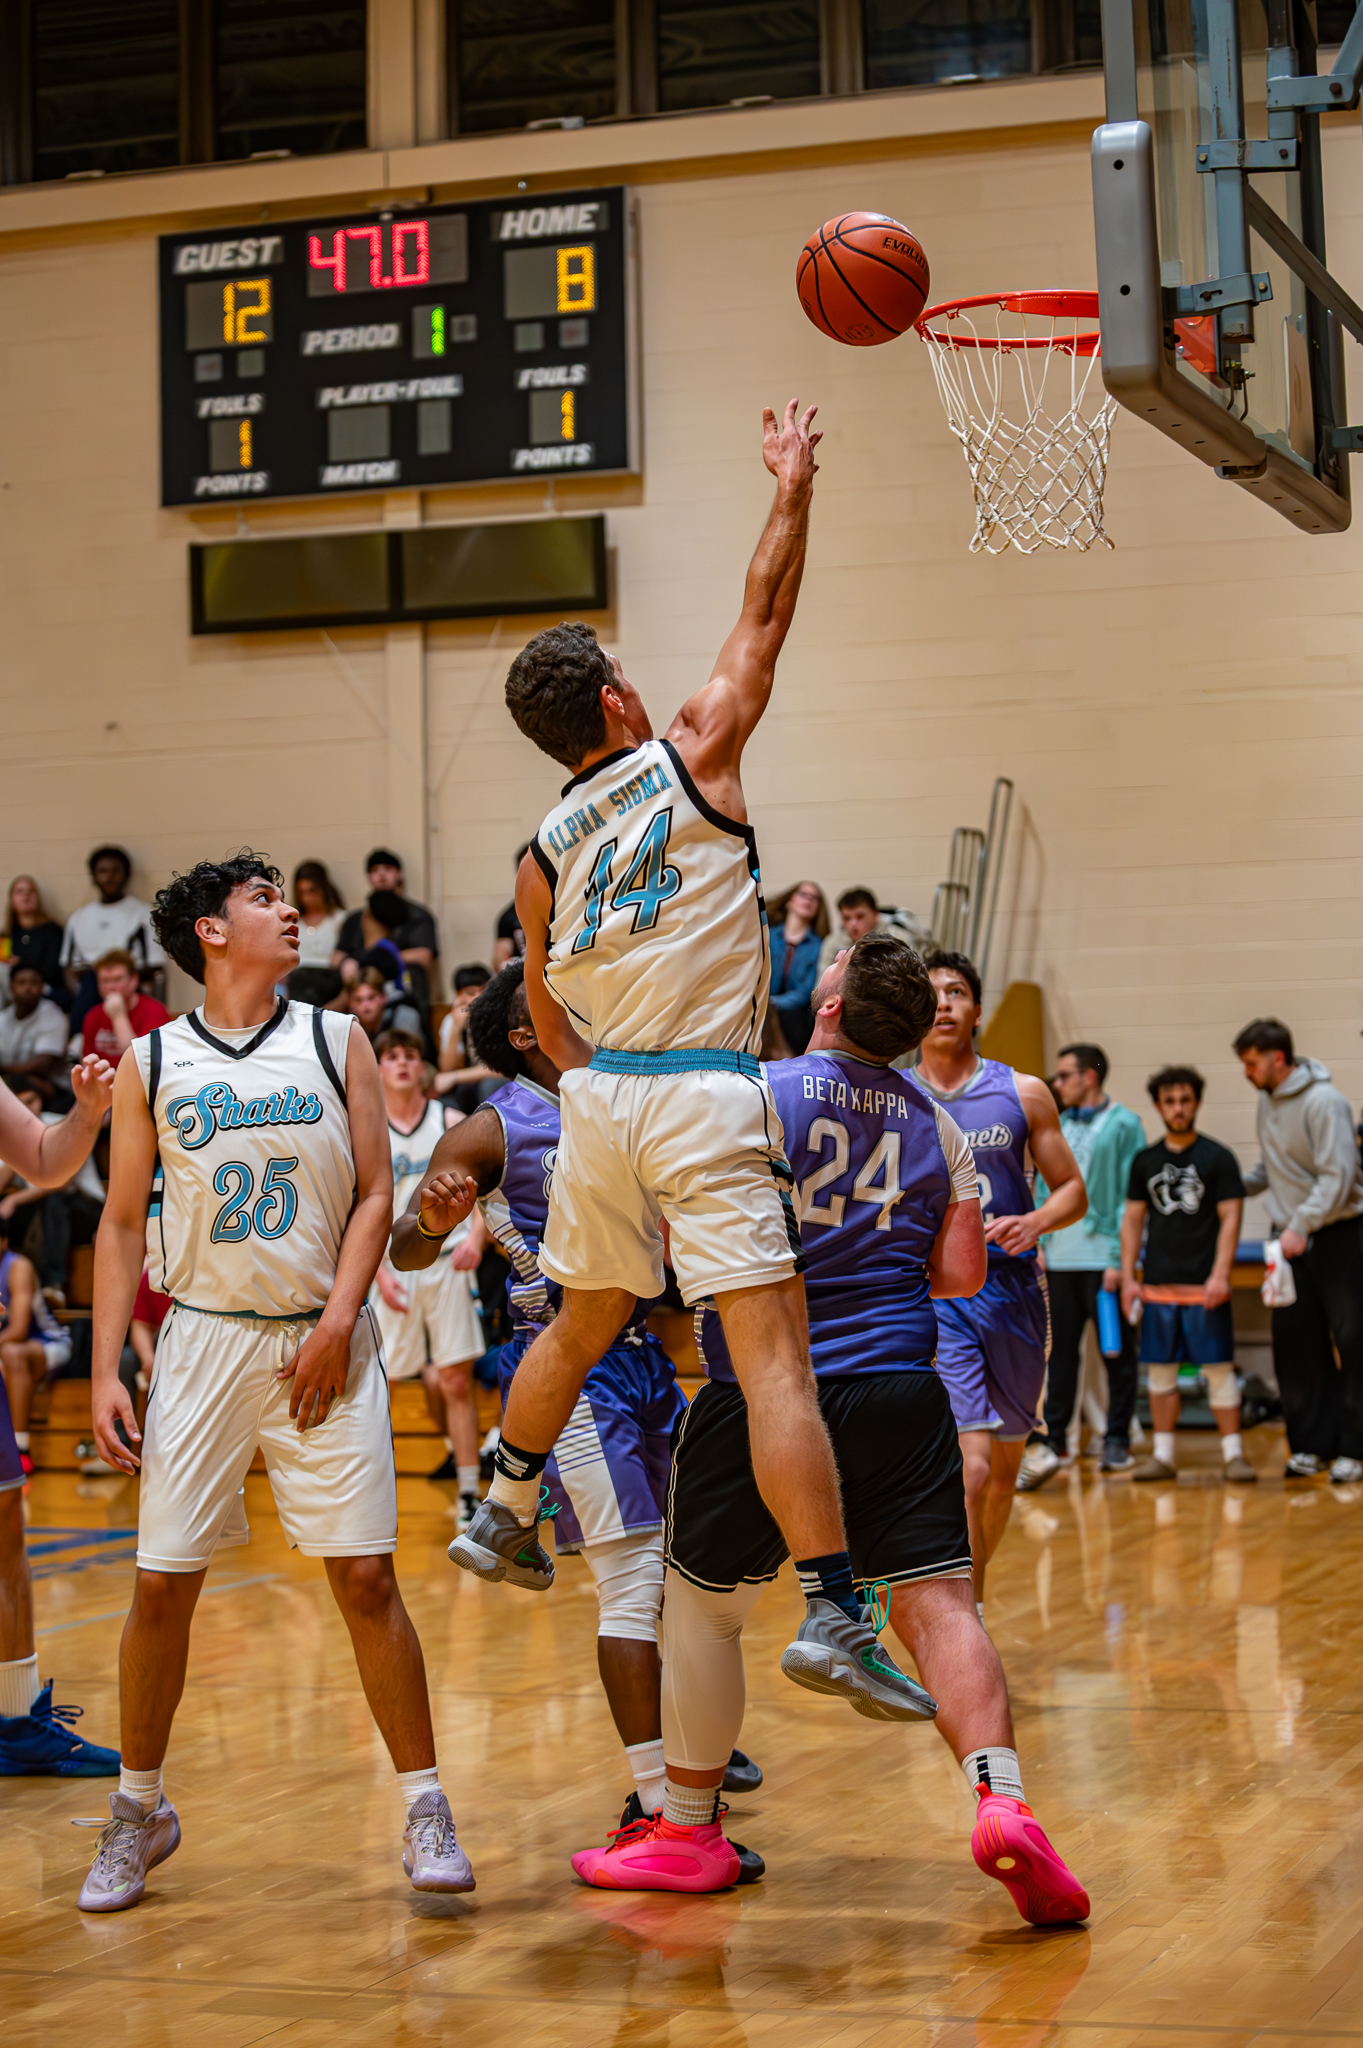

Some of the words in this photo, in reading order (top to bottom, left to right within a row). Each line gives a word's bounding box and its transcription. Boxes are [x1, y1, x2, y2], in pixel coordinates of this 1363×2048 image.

[501, 204, 598, 238] HOME
[176, 237, 281, 273] GUEST
[309, 220, 429, 292] 47.0
[556, 245, 594, 313] 8
[223, 278, 271, 344] 12
[431, 306, 445, 356] 1
[304, 324, 399, 355] PERIOD
[319, 376, 460, 407] PLAYER-FOUL
[518, 366, 586, 389] FOULS
[199, 395, 262, 418] FOULS
[561, 390, 575, 442] 1
[239, 419, 253, 469] 1
[514, 445, 591, 470] POINTS
[195, 472, 268, 495] POINTS
[321, 461, 397, 486] MATCH
[547, 802, 607, 858] ALPHA
[608, 762, 673, 817] SIGMA
[571, 805, 682, 955] 14
[165, 1081, 323, 1150] Sharks
[802, 1074, 847, 1108] BETA
[850, 1086, 909, 1120] KAPPA
[963, 1122, 1013, 1151] nets
[801, 1115, 906, 1232] 24
[210, 1156, 299, 1244] 25
